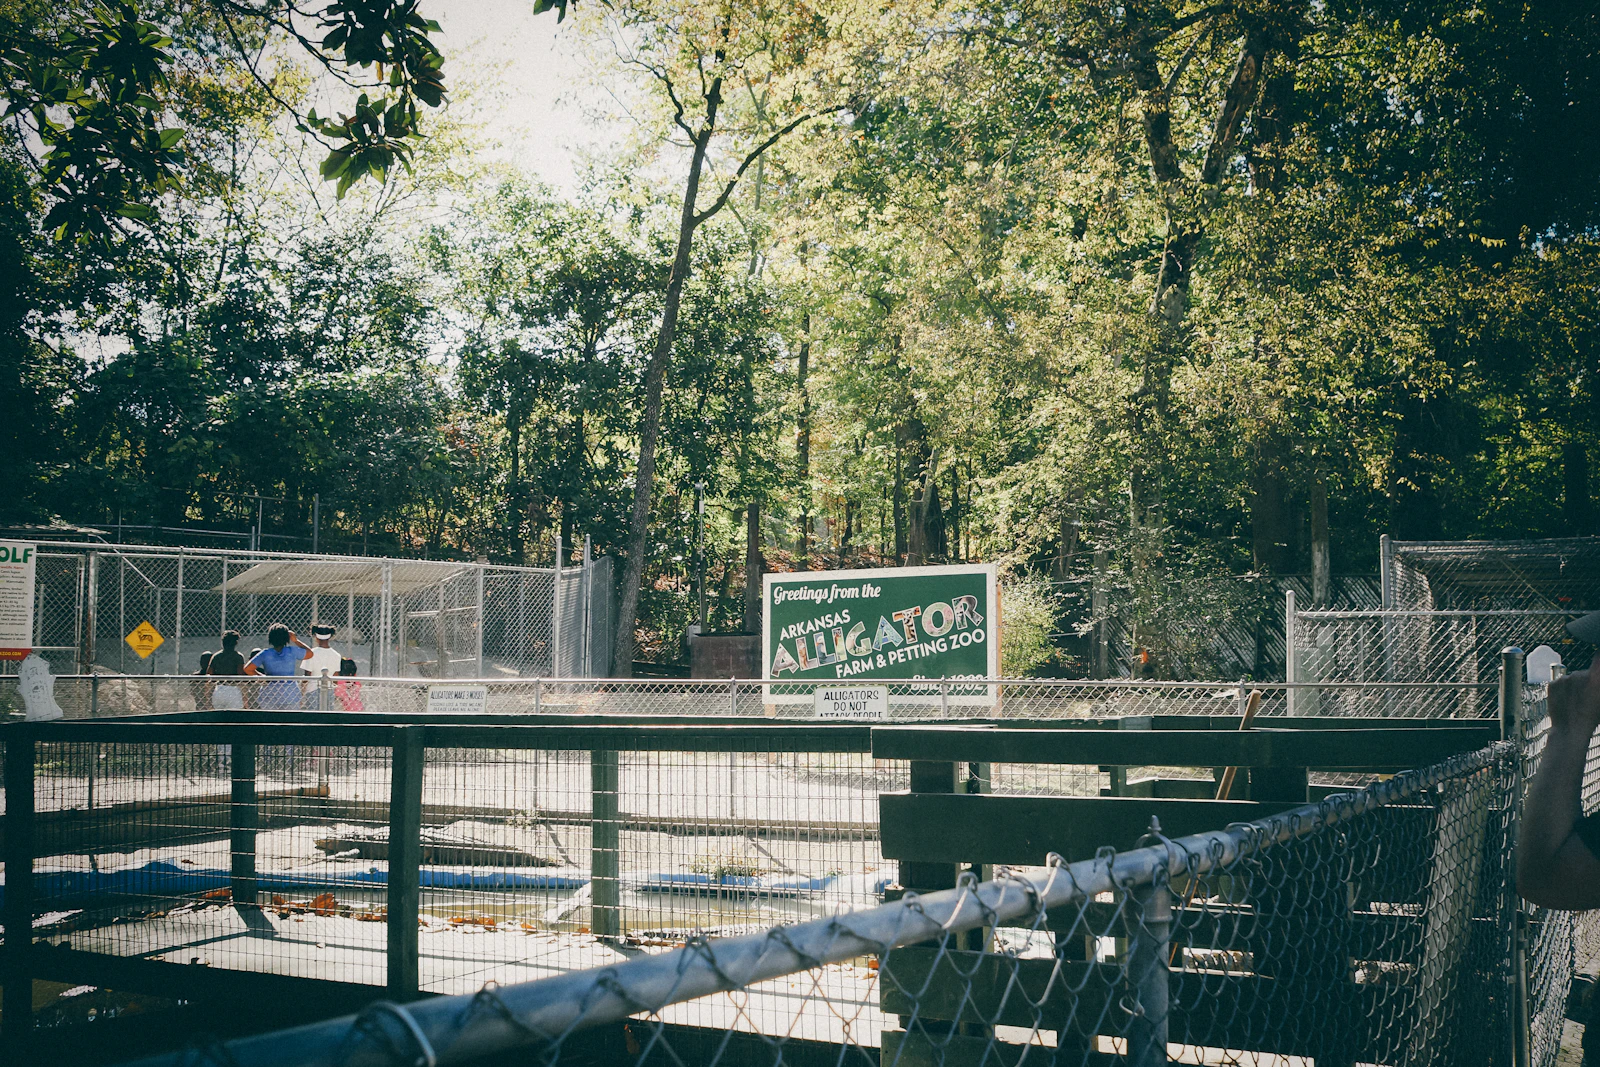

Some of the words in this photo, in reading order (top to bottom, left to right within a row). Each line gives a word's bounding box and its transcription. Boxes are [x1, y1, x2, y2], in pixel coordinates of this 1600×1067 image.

[774, 585, 829, 605] Greetings
[830, 583, 860, 604] from
[861, 583, 882, 598] the
[780, 609, 851, 642] ARKANSAS
[770, 594, 984, 678] ALLIGATOR
[835, 655, 874, 679] FARM
[876, 652, 887, 668] &
[888, 637, 947, 666] PETTING
[949, 629, 985, 649] ZOO
[910, 674, 943, 693] Sinc
[431, 691, 453, 699] ALLIGATORS
[454, 691, 466, 699] MAKE
[823, 690, 879, 701] ALLIGATORS
[833, 701, 847, 711] DO
[849, 701, 868, 711] NOT
